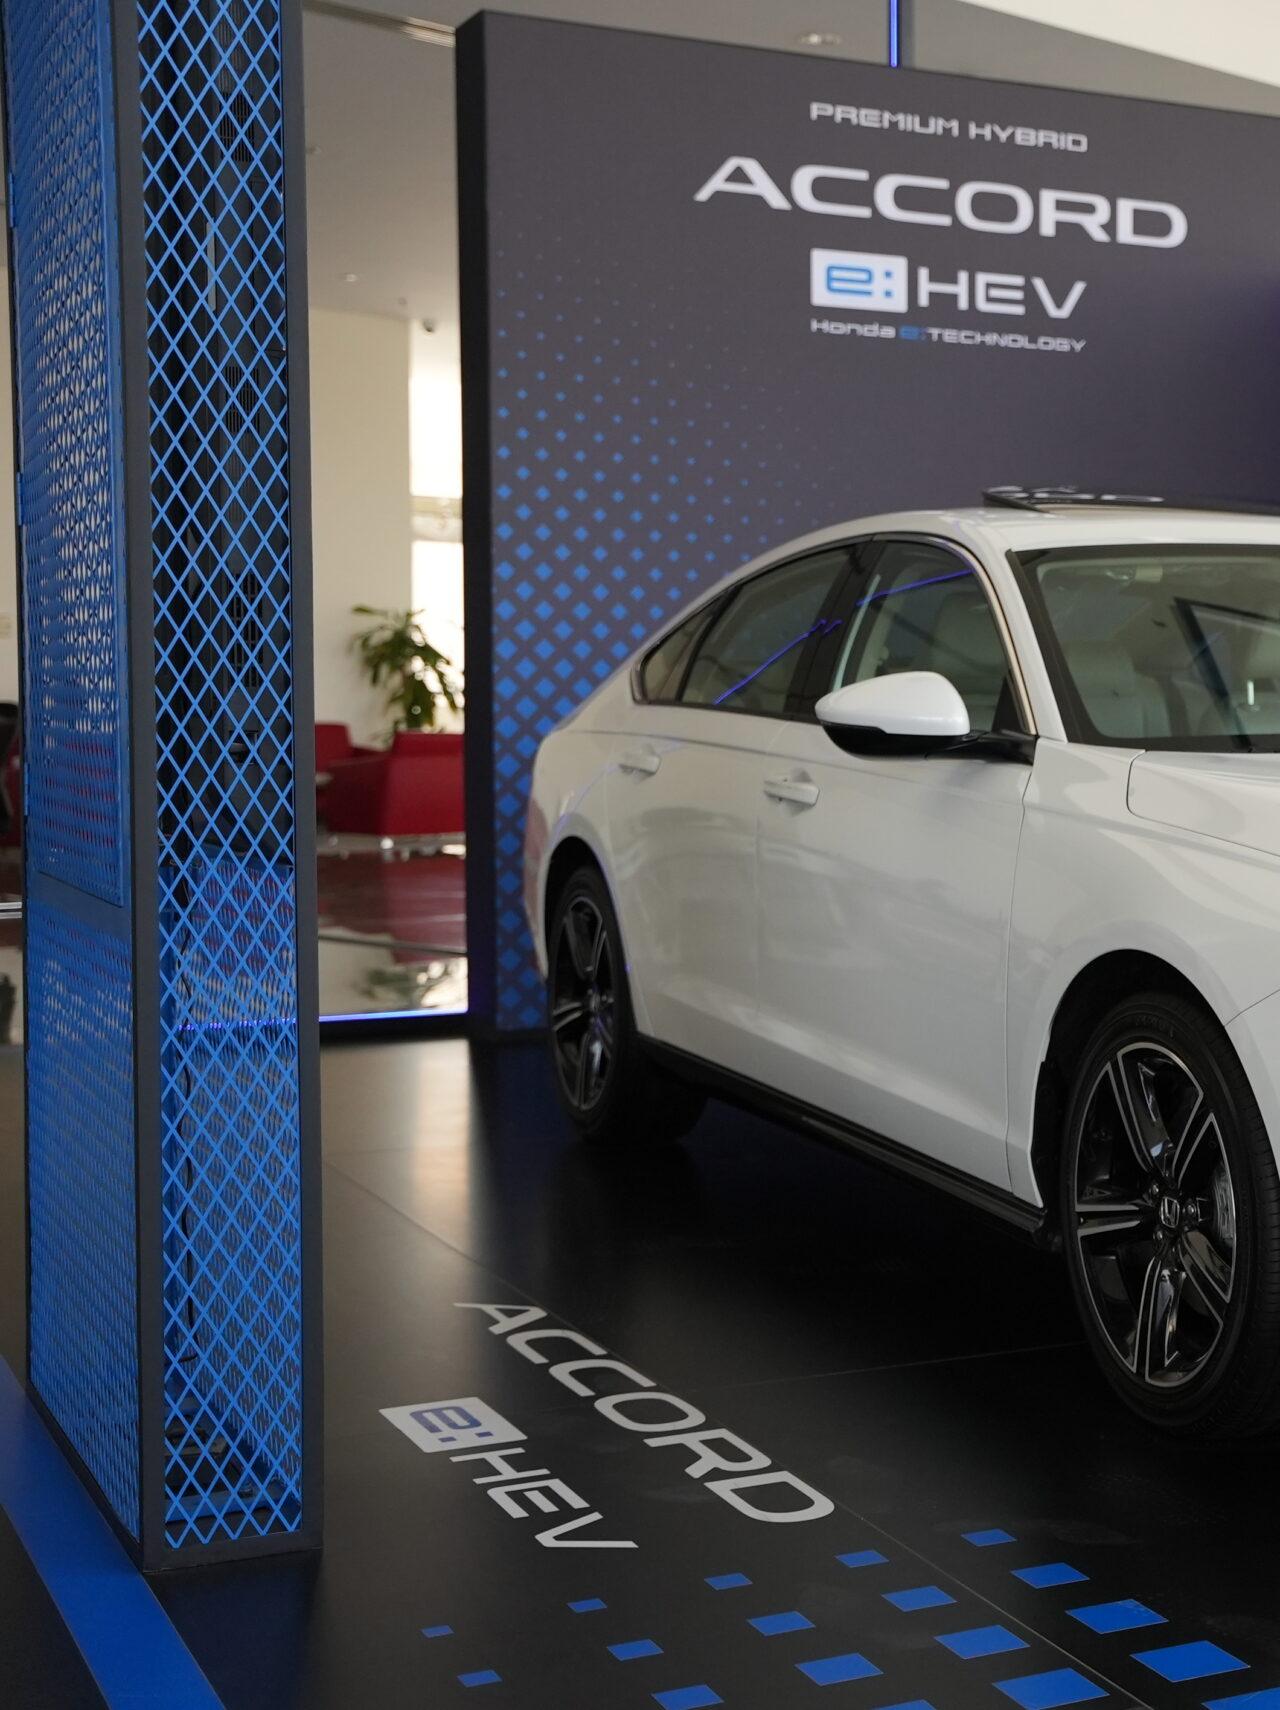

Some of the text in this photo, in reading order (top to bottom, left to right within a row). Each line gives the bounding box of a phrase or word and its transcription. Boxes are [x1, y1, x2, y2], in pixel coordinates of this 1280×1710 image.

[810, 101, 1088, 153] PREMIUM HYBRID
[693, 156, 1188, 249] ACCORD
[810, 318, 896, 339] Honda
[452, 1302, 835, 1523] ACCORD
